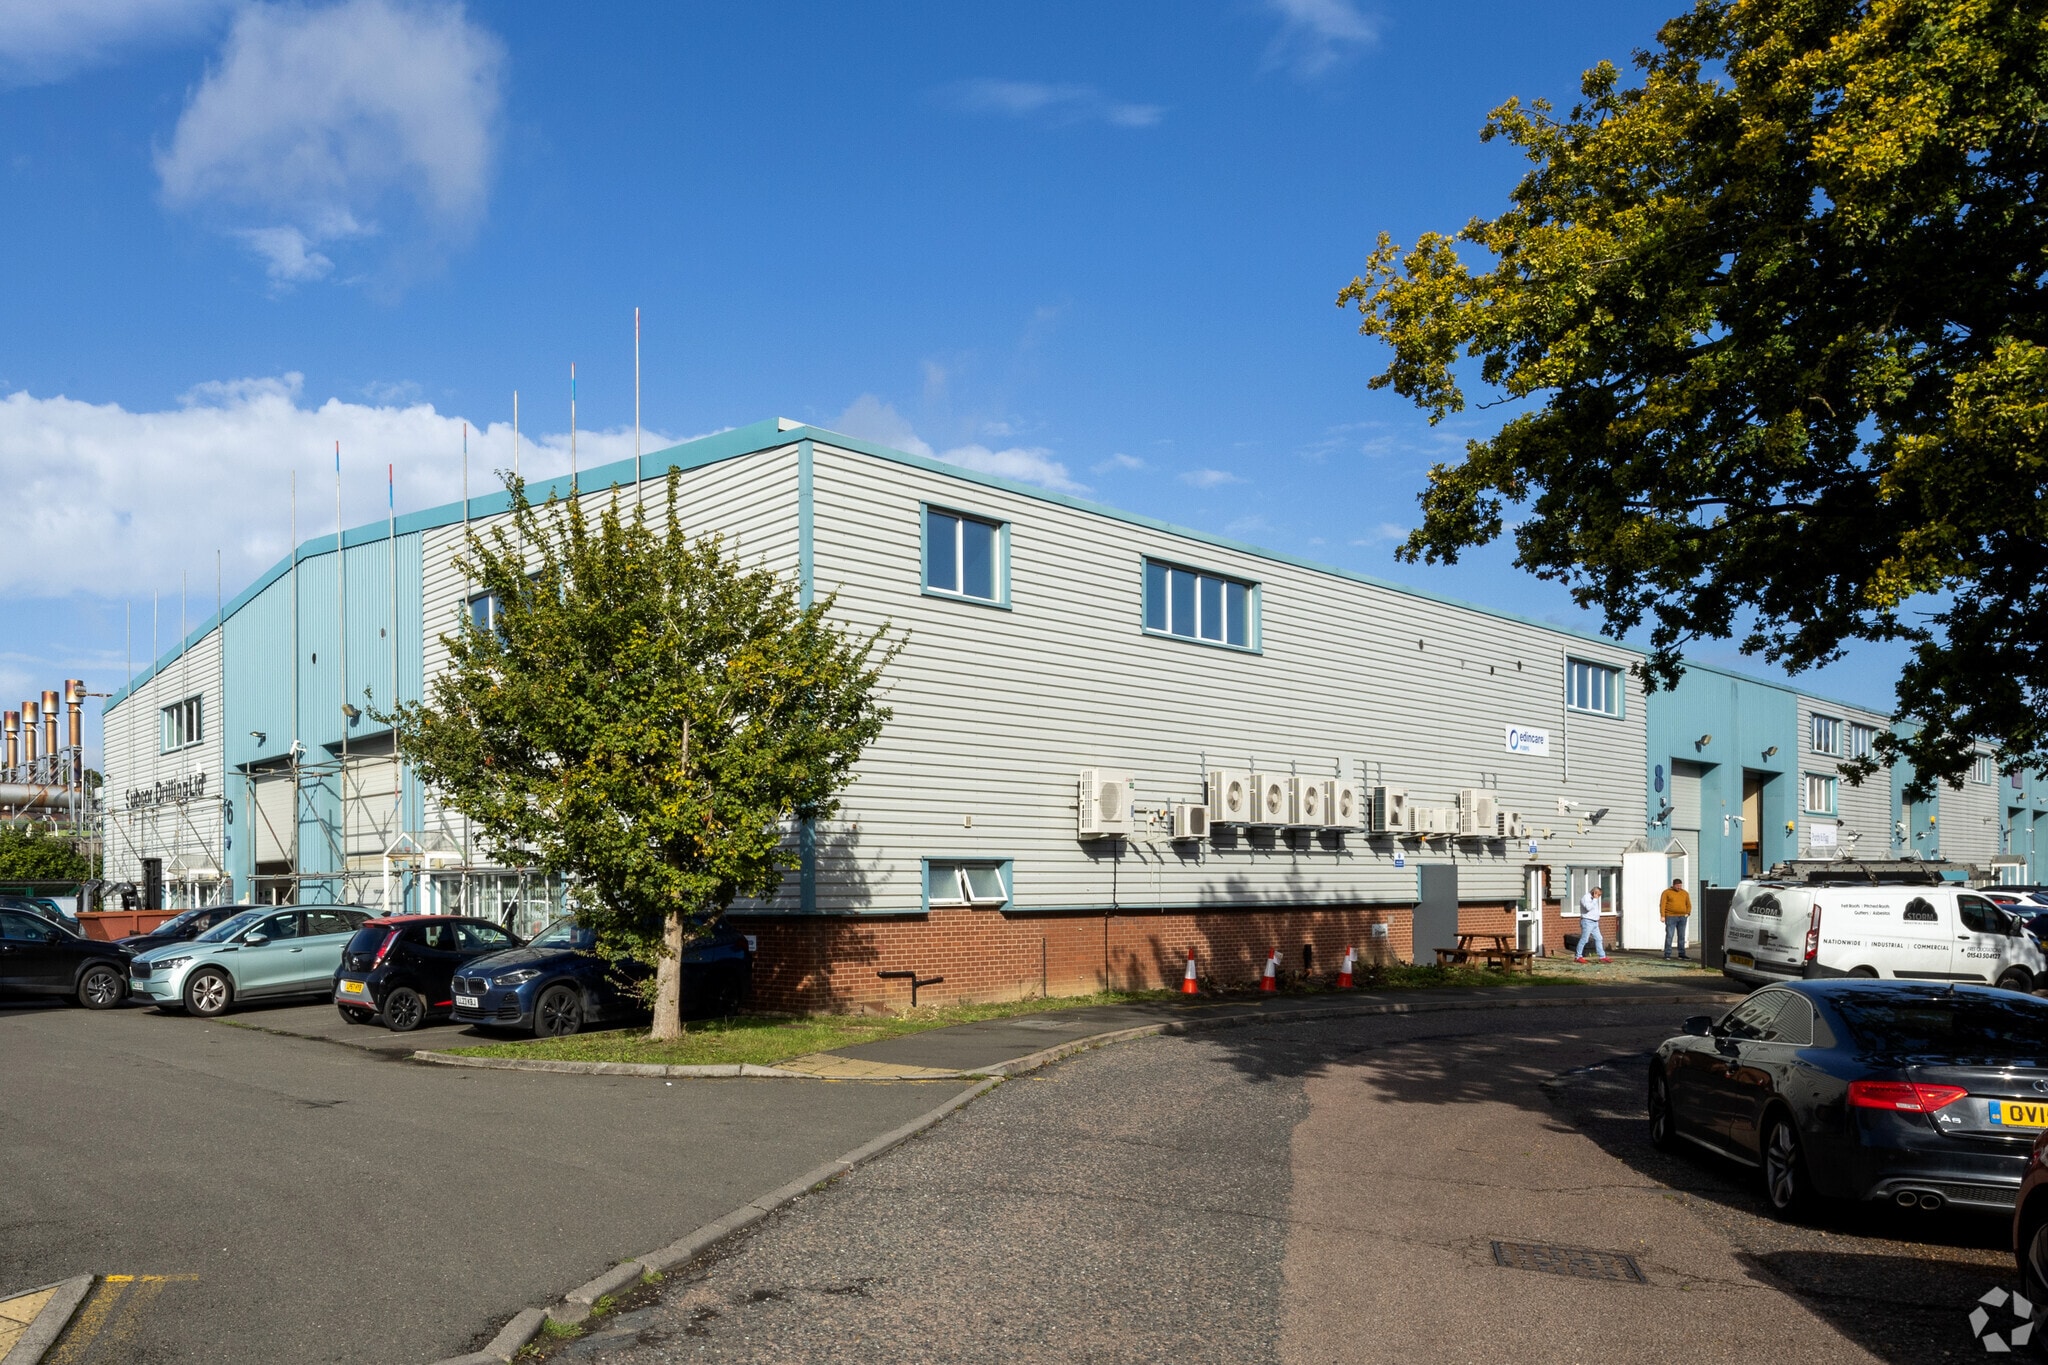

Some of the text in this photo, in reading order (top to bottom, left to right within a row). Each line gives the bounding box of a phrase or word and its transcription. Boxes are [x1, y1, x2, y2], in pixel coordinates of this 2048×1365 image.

[1520, 732, 1543, 744] edincare
[1752, 906, 1778, 916] STORM
[1940, 1114, 1961, 1124] A5
[2010, 1105, 2048, 1123] OV1
